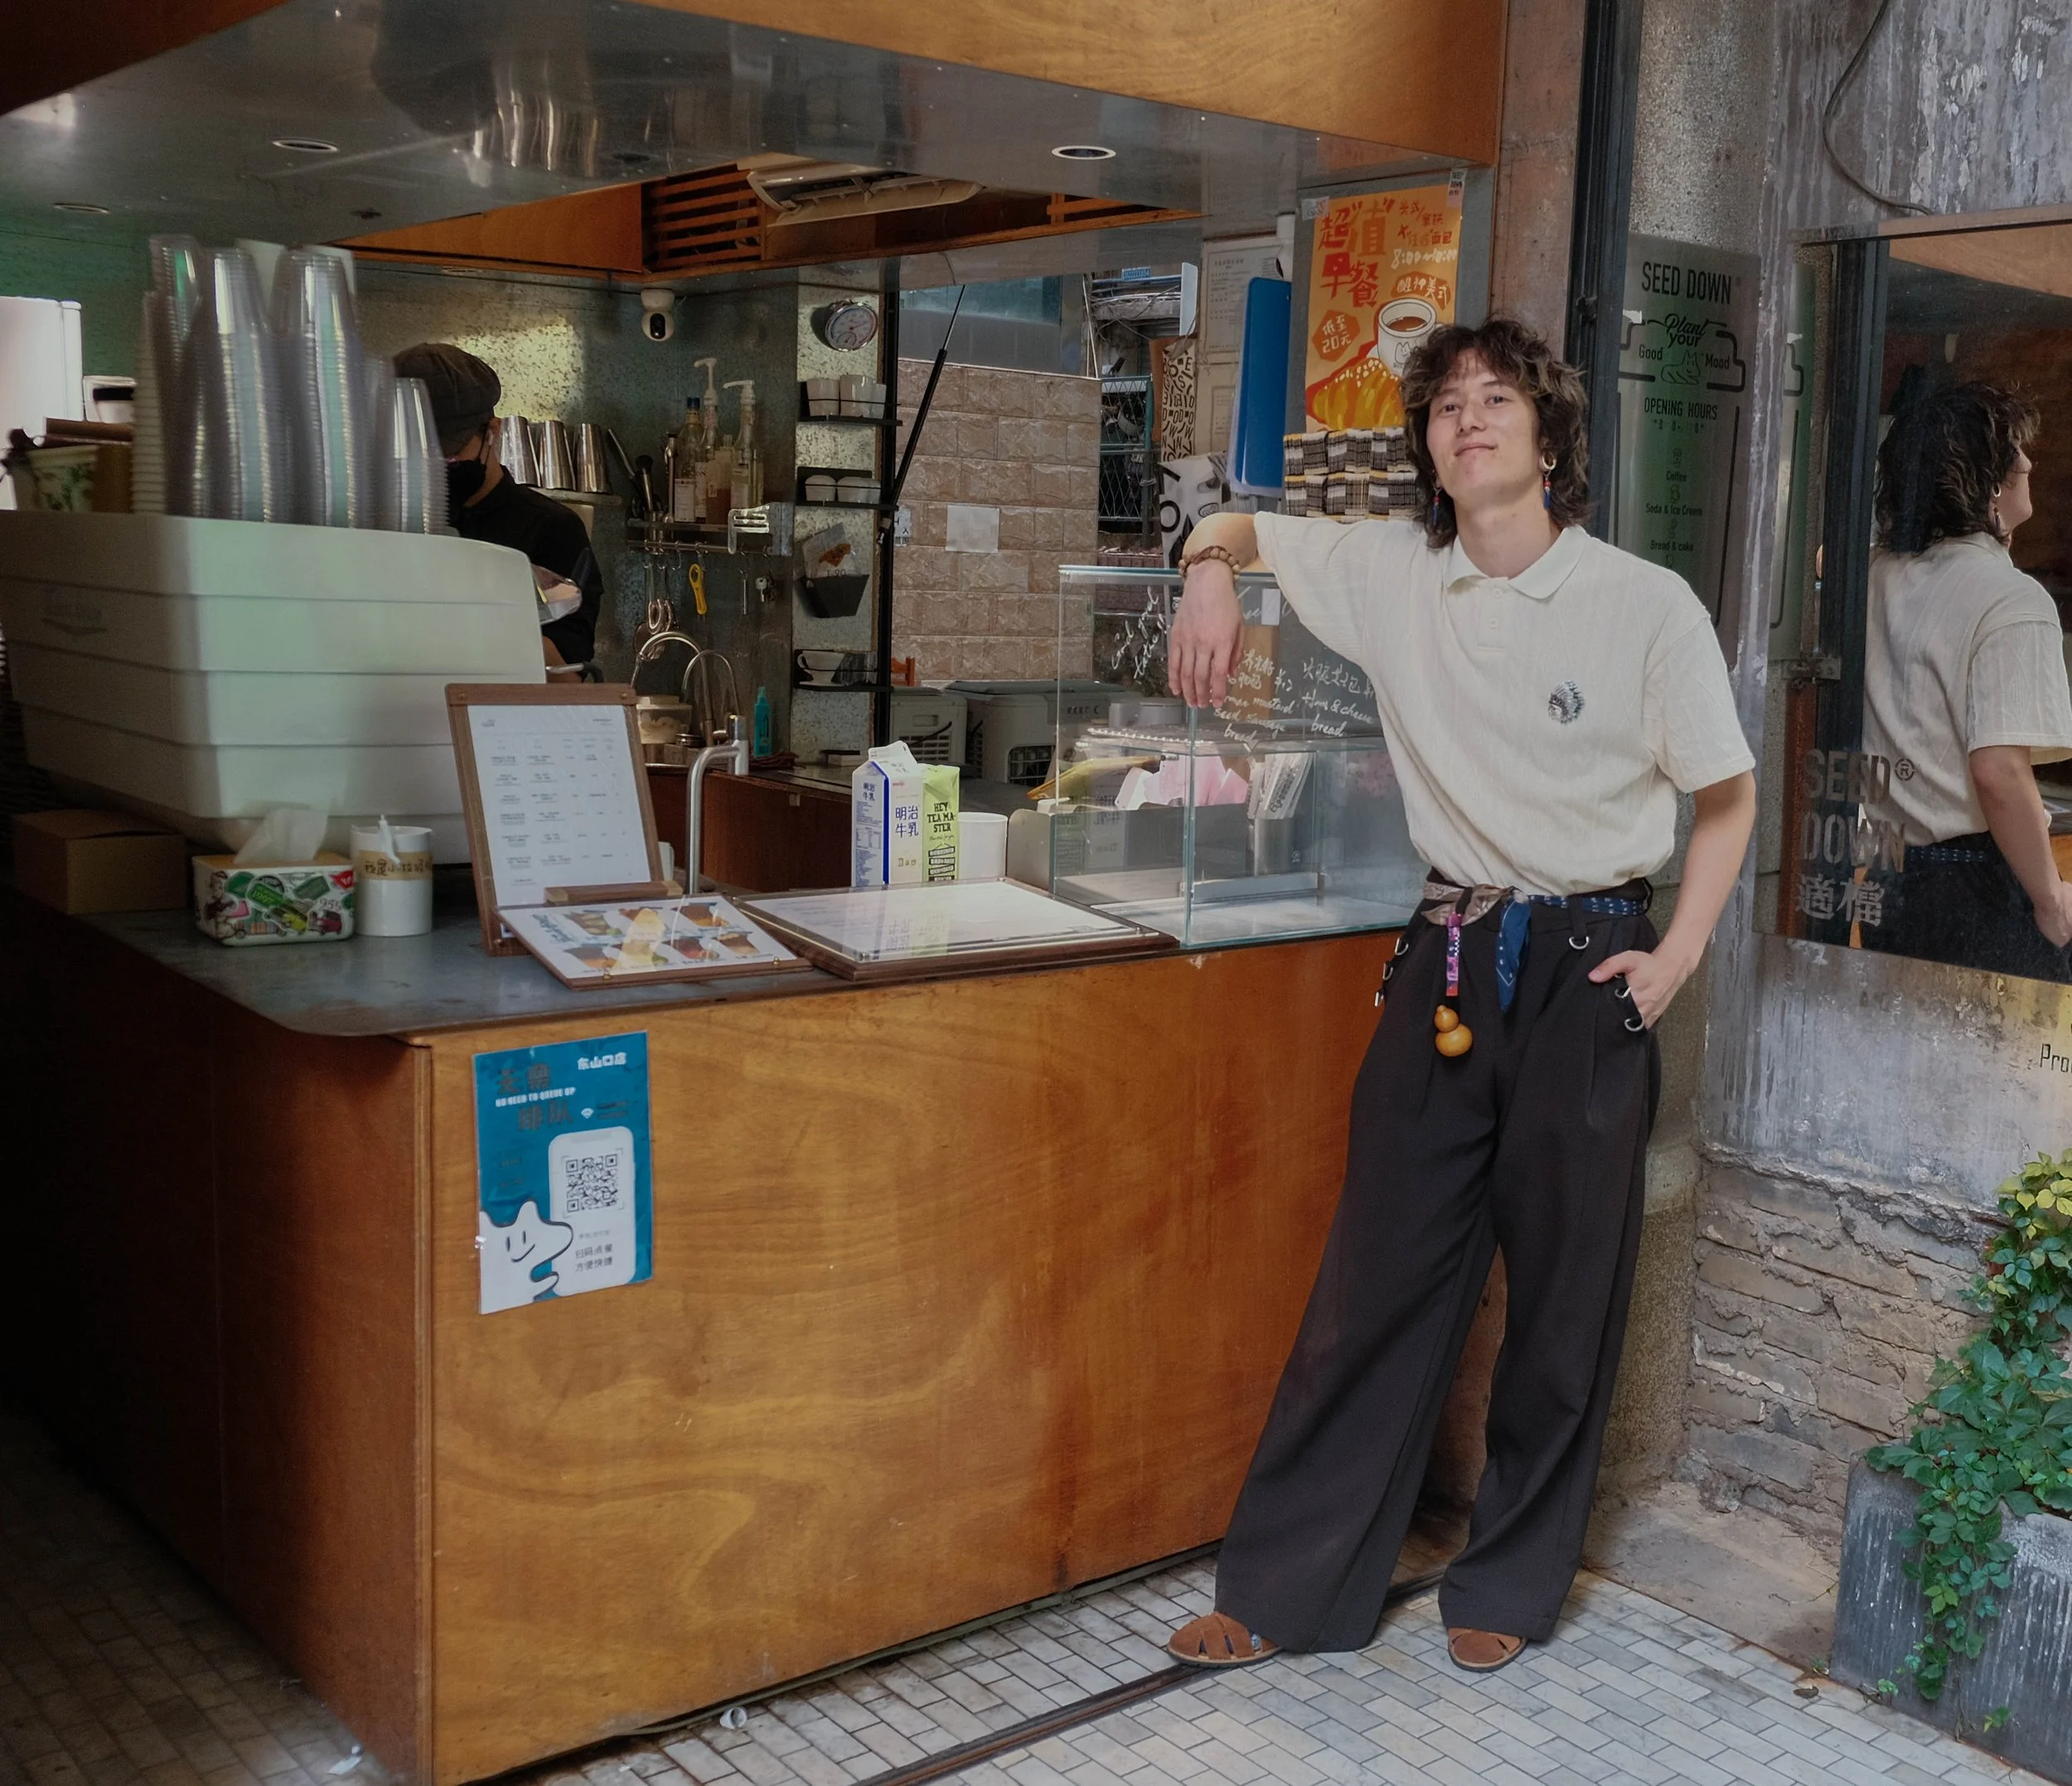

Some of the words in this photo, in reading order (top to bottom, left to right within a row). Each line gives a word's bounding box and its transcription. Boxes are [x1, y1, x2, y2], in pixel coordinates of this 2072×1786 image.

[1319, 251, 1379, 309] 早餐
[1642, 261, 1680, 297] SEED
[1687, 269, 1731, 306] DOWN
[1660, 313, 1718, 337] Plant
[1322, 333, 1353, 354] 20元
[1639, 345, 1663, 361] Good
[1705, 353, 1731, 370] Mood
[1644, 398, 1683, 417] OPENING
[1687, 402, 1717, 420] HOURS
[1667, 471, 1687, 482] Coffee
[1645, 503, 1662, 514] Soda
[1651, 540, 1670, 550] Bread
[1311, 714, 1348, 738] bread
[895, 805, 919, 821] 明治
[933, 802, 949, 812] HEY
[927, 814, 942, 823] TEA
[895, 822, 919, 838] 牛乳
[933, 823, 951, 834] STER
[1800, 810, 1905, 874] DOWN
[2040, 1043, 2072, 1073] Pro
